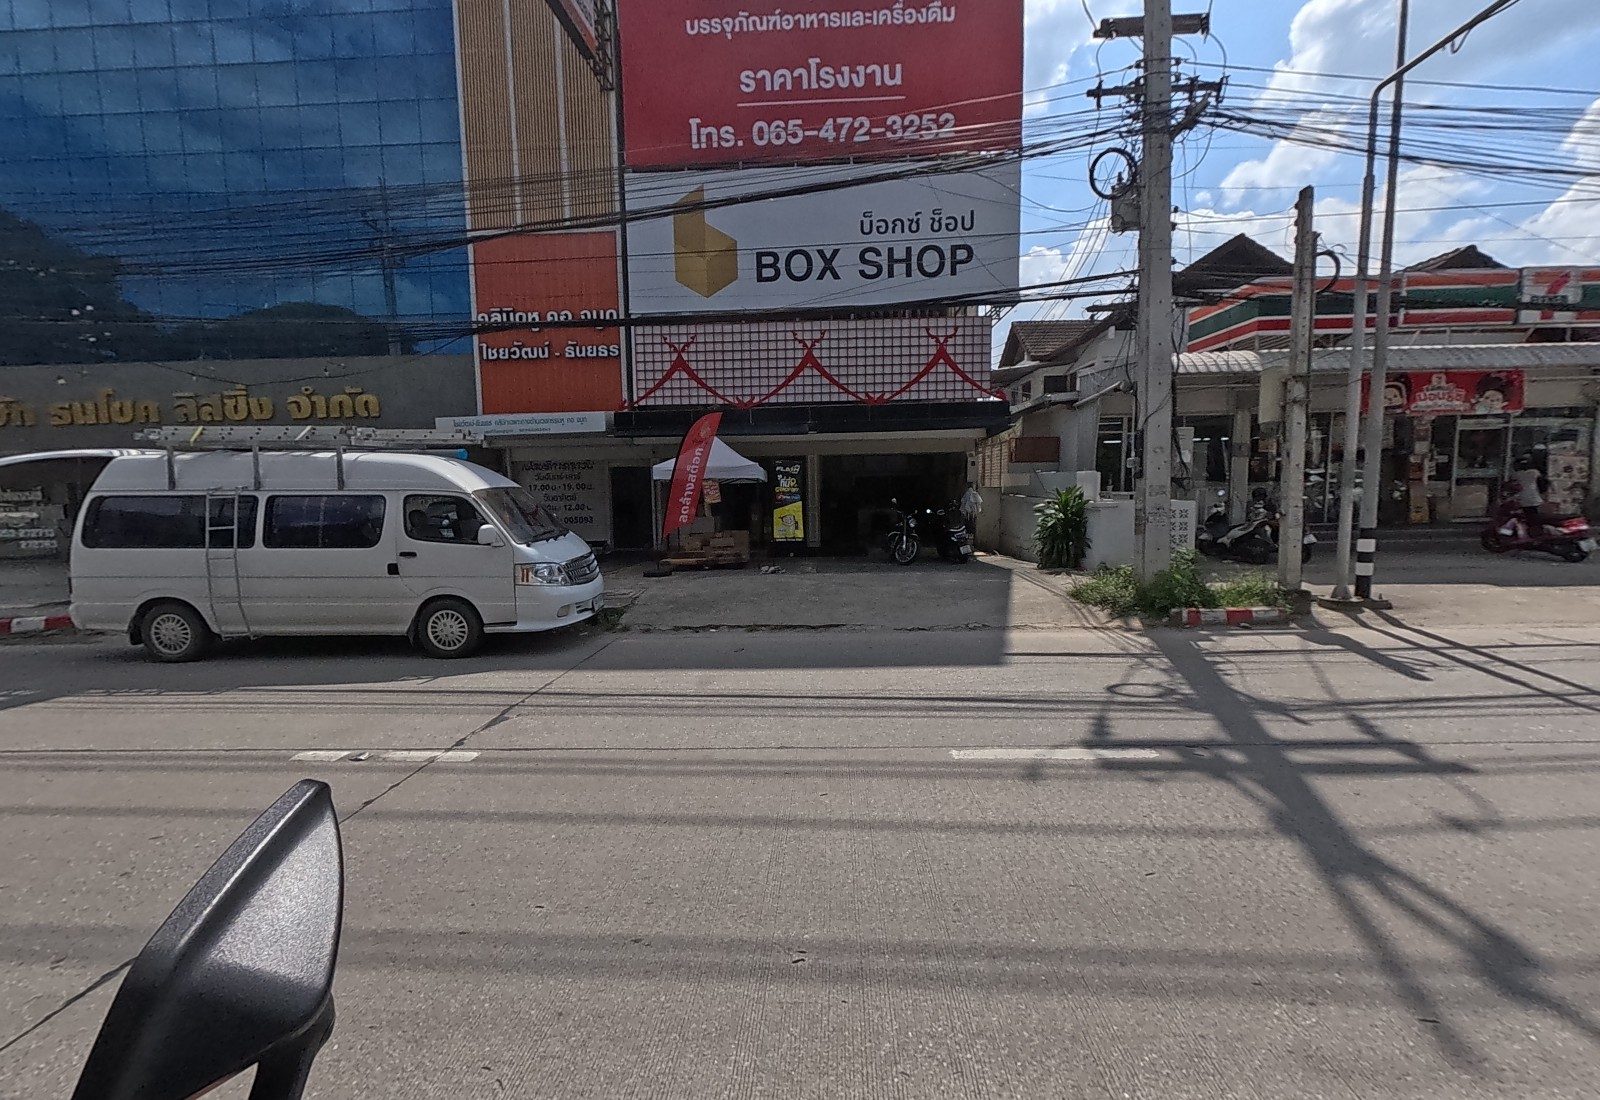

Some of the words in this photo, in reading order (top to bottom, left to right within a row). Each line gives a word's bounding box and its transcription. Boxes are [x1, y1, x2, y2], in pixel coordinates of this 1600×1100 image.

[685, 0, 956, 40] บรรจุภัณฑ์อาหารและเครื่องดืม
[739, 58, 902, 93] ราคาโรงงาน
[688, 118, 744, 149] โทร.
[752, 112, 956, 147] 065-472-3252
[859, 210, 922, 236] บ็อกซ์
[929, 208, 975, 233] ช็อป
[755, 248, 842, 283] BOX
[858, 243, 974, 280] SHOP
[479, 341, 550, 360] ไชยวัฒน์
[565, 340, 620, 358] ธันยธร
[286, 384, 381, 420] จำกัด
